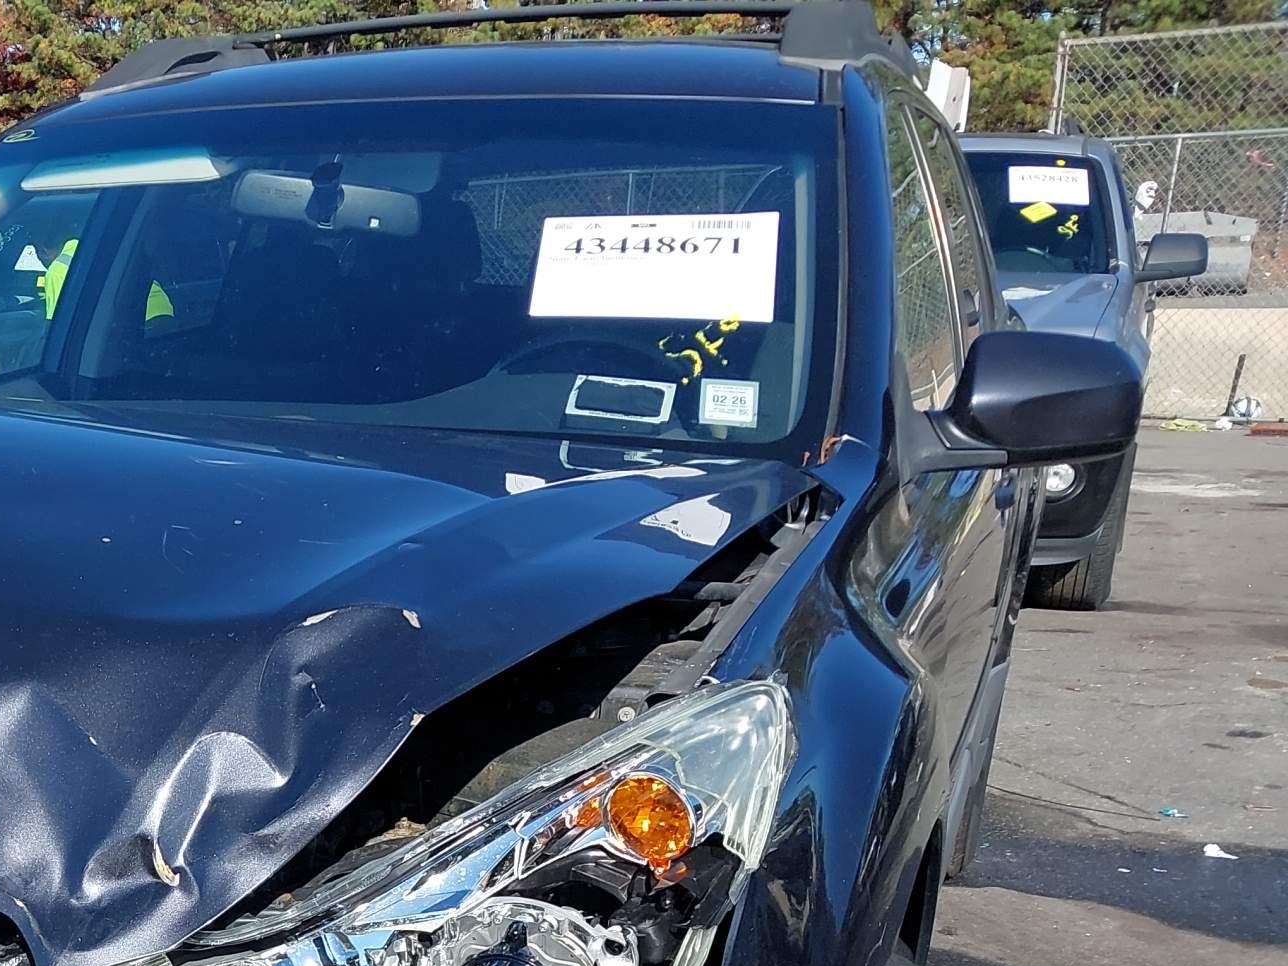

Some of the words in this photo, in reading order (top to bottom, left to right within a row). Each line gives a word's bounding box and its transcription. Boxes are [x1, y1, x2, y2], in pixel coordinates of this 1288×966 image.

[563, 236, 742, 255] 43448671
[712, 393, 728, 404] 02
[731, 395, 747, 406] 26
